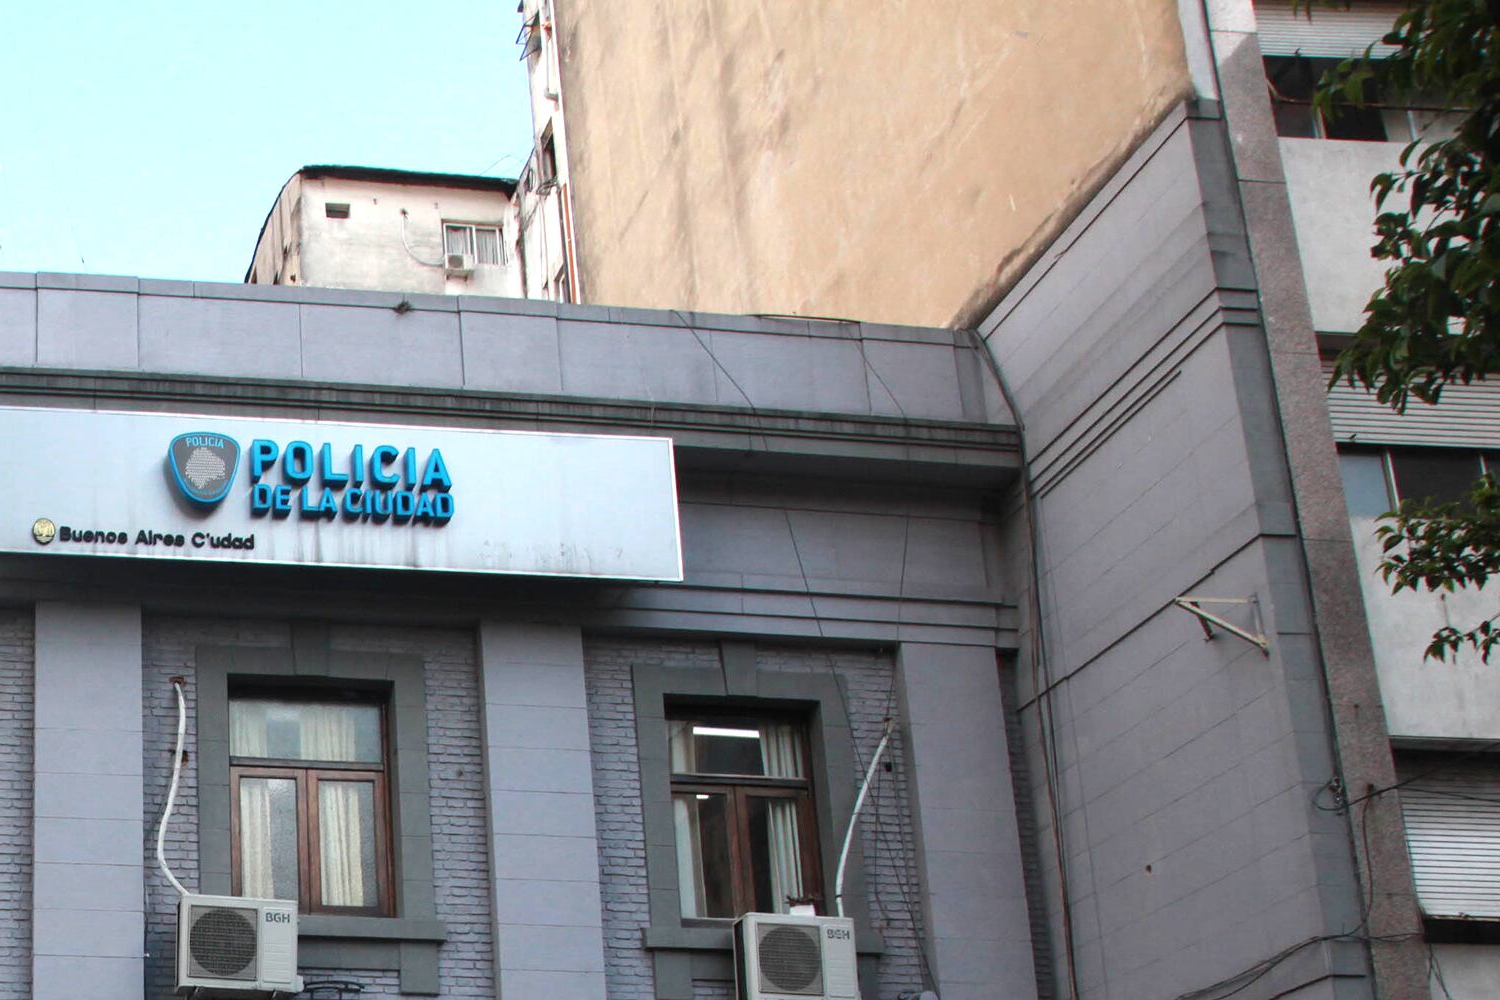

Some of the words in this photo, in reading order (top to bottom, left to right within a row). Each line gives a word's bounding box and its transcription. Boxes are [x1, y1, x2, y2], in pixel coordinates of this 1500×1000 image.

[252, 439, 452, 489] POLICIA
[252, 484, 291, 513] DE
[301, 487, 337, 516] LA
[345, 488, 454, 521] CIUDAD
[59, 526, 128, 545] Buenos
[135, 530, 185, 548] Aires
[265, 912, 290, 924] BGH
